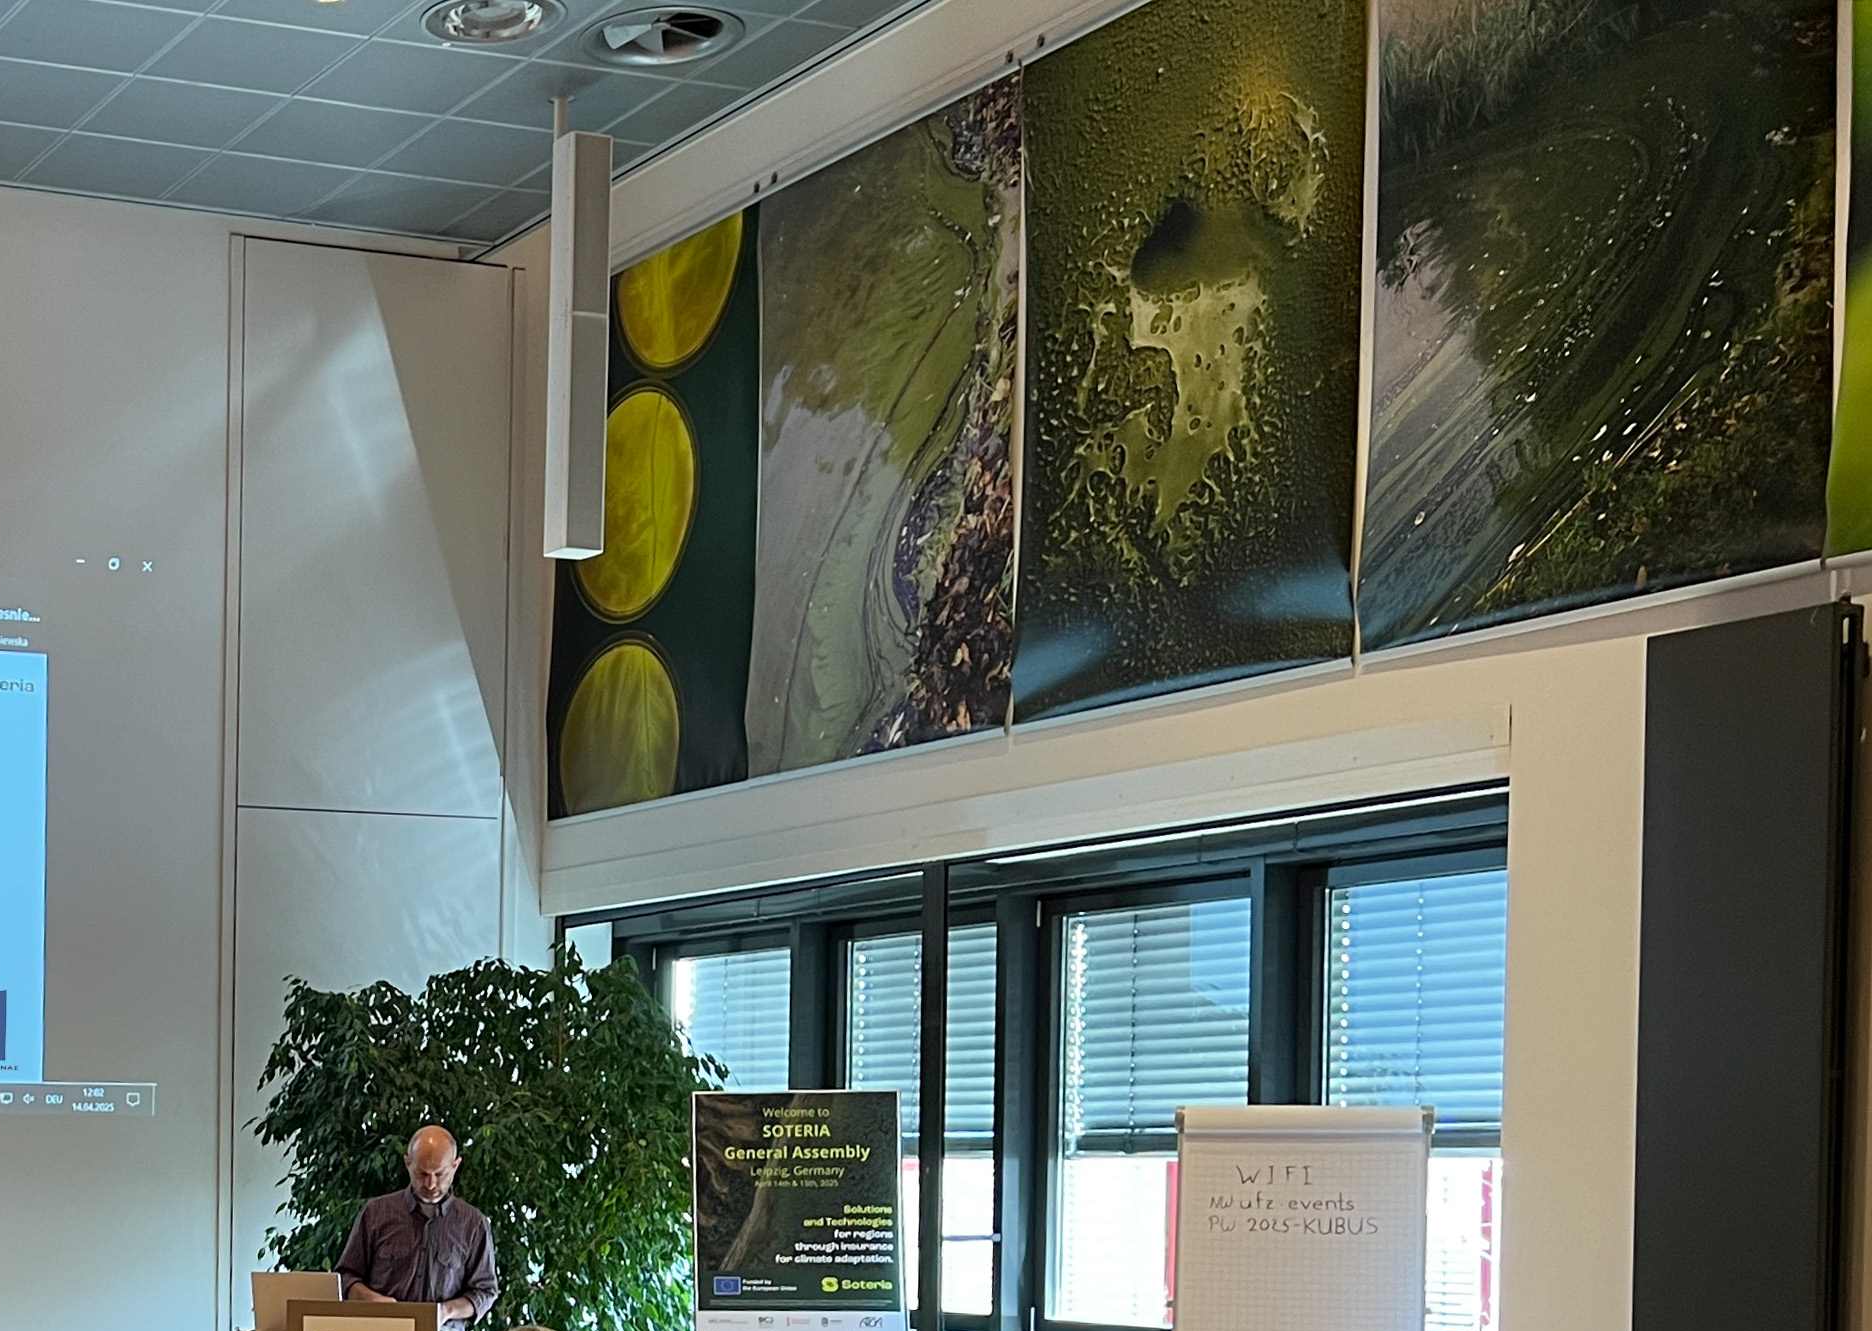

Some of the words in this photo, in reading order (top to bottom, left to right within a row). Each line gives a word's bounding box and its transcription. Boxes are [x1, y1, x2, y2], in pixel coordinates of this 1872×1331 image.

[45, 1094, 63, 1105] DEU
[72, 1103, 114, 1113] 14.04.2025
[762, 1107, 815, 1118] Welcome
[818, 1108, 830, 1117] to
[762, 1124, 831, 1138] SOTERIA
[724, 1146, 787, 1160] General
[792, 1145, 870, 1161] Assembly
[750, 1166, 790, 1178] Leipzig,
[793, 1165, 844, 1178] Germany
[844, 1205, 893, 1214] Solutions
[803, 1219, 823, 1227] and
[826, 1217, 893, 1228] Technologies
[834, 1230, 850, 1238] for
[853, 1231, 893, 1240] regions
[795, 1242, 839, 1252] through
[841, 1243, 894, 1251] insurance
[776, 1254, 792, 1263] for
[795, 1254, 832, 1263] climate
[835, 1254, 893, 1265] adaptation.
[842, 1280, 893, 1290] Soteria
